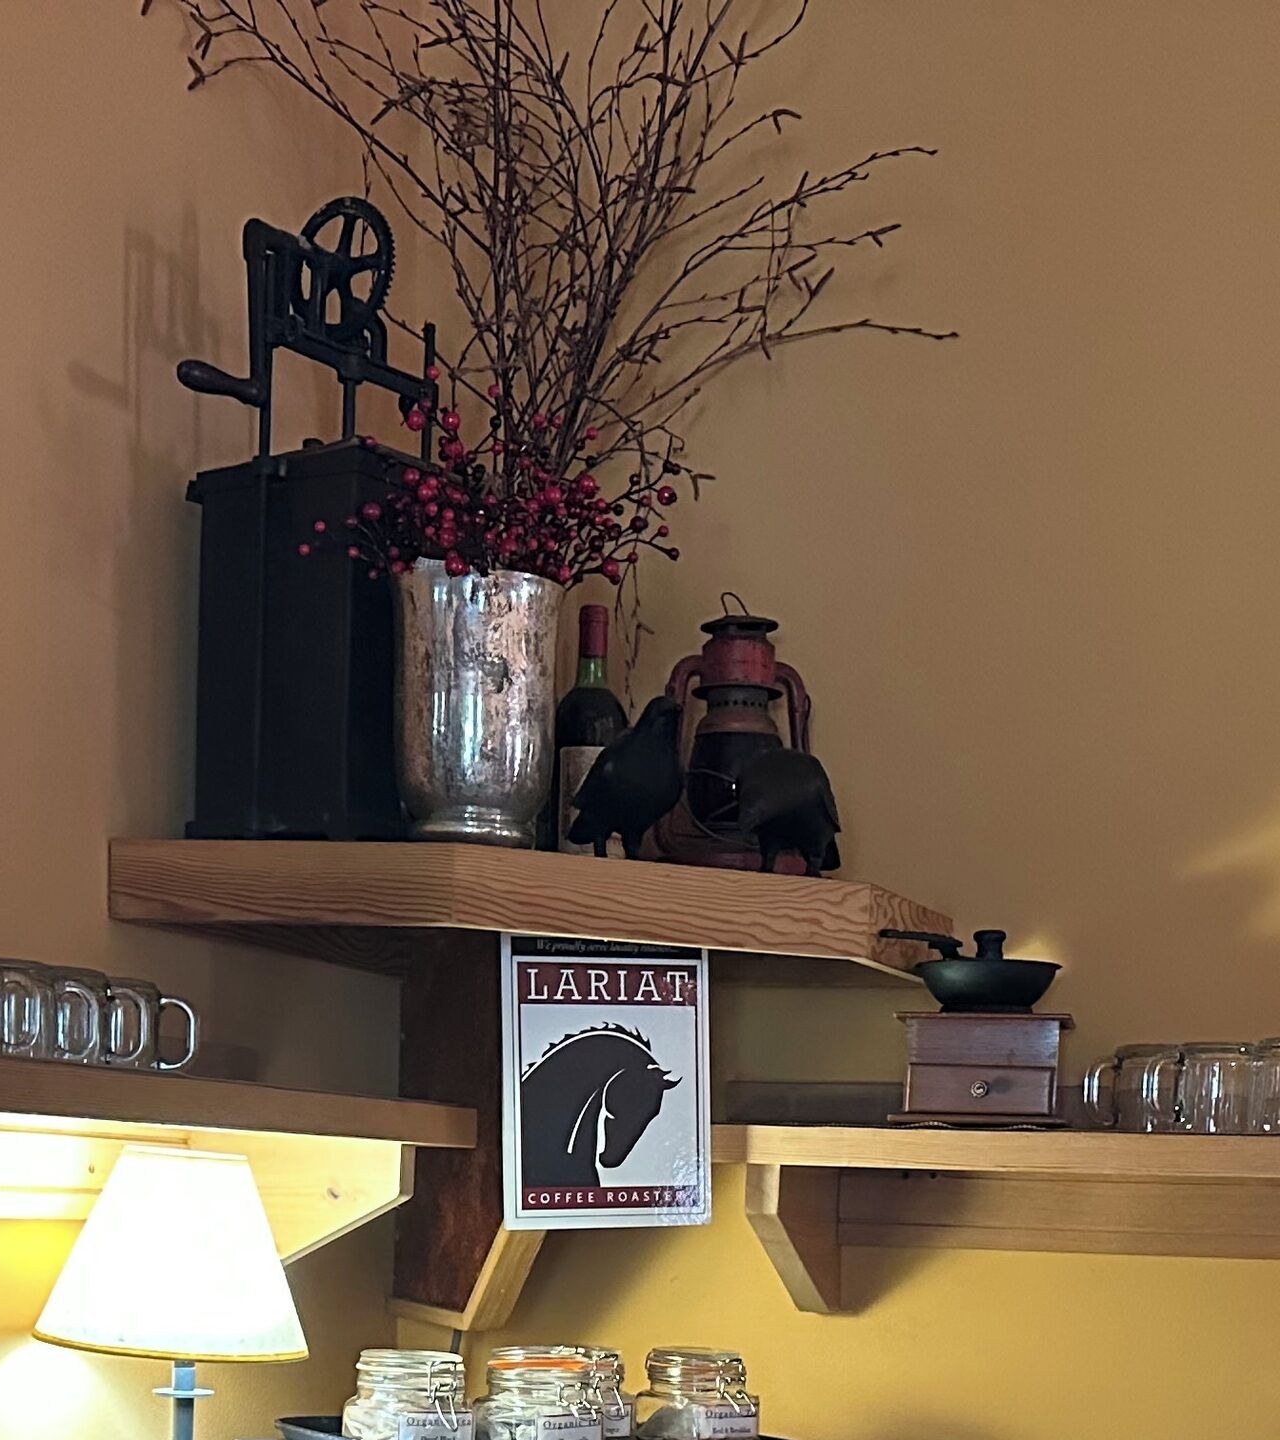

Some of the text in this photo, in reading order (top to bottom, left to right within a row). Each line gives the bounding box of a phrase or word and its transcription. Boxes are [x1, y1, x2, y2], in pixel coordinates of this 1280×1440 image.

[527, 968, 689, 1002] LARIAT
[527, 1190, 694, 1205] COFFEE ROASTER
